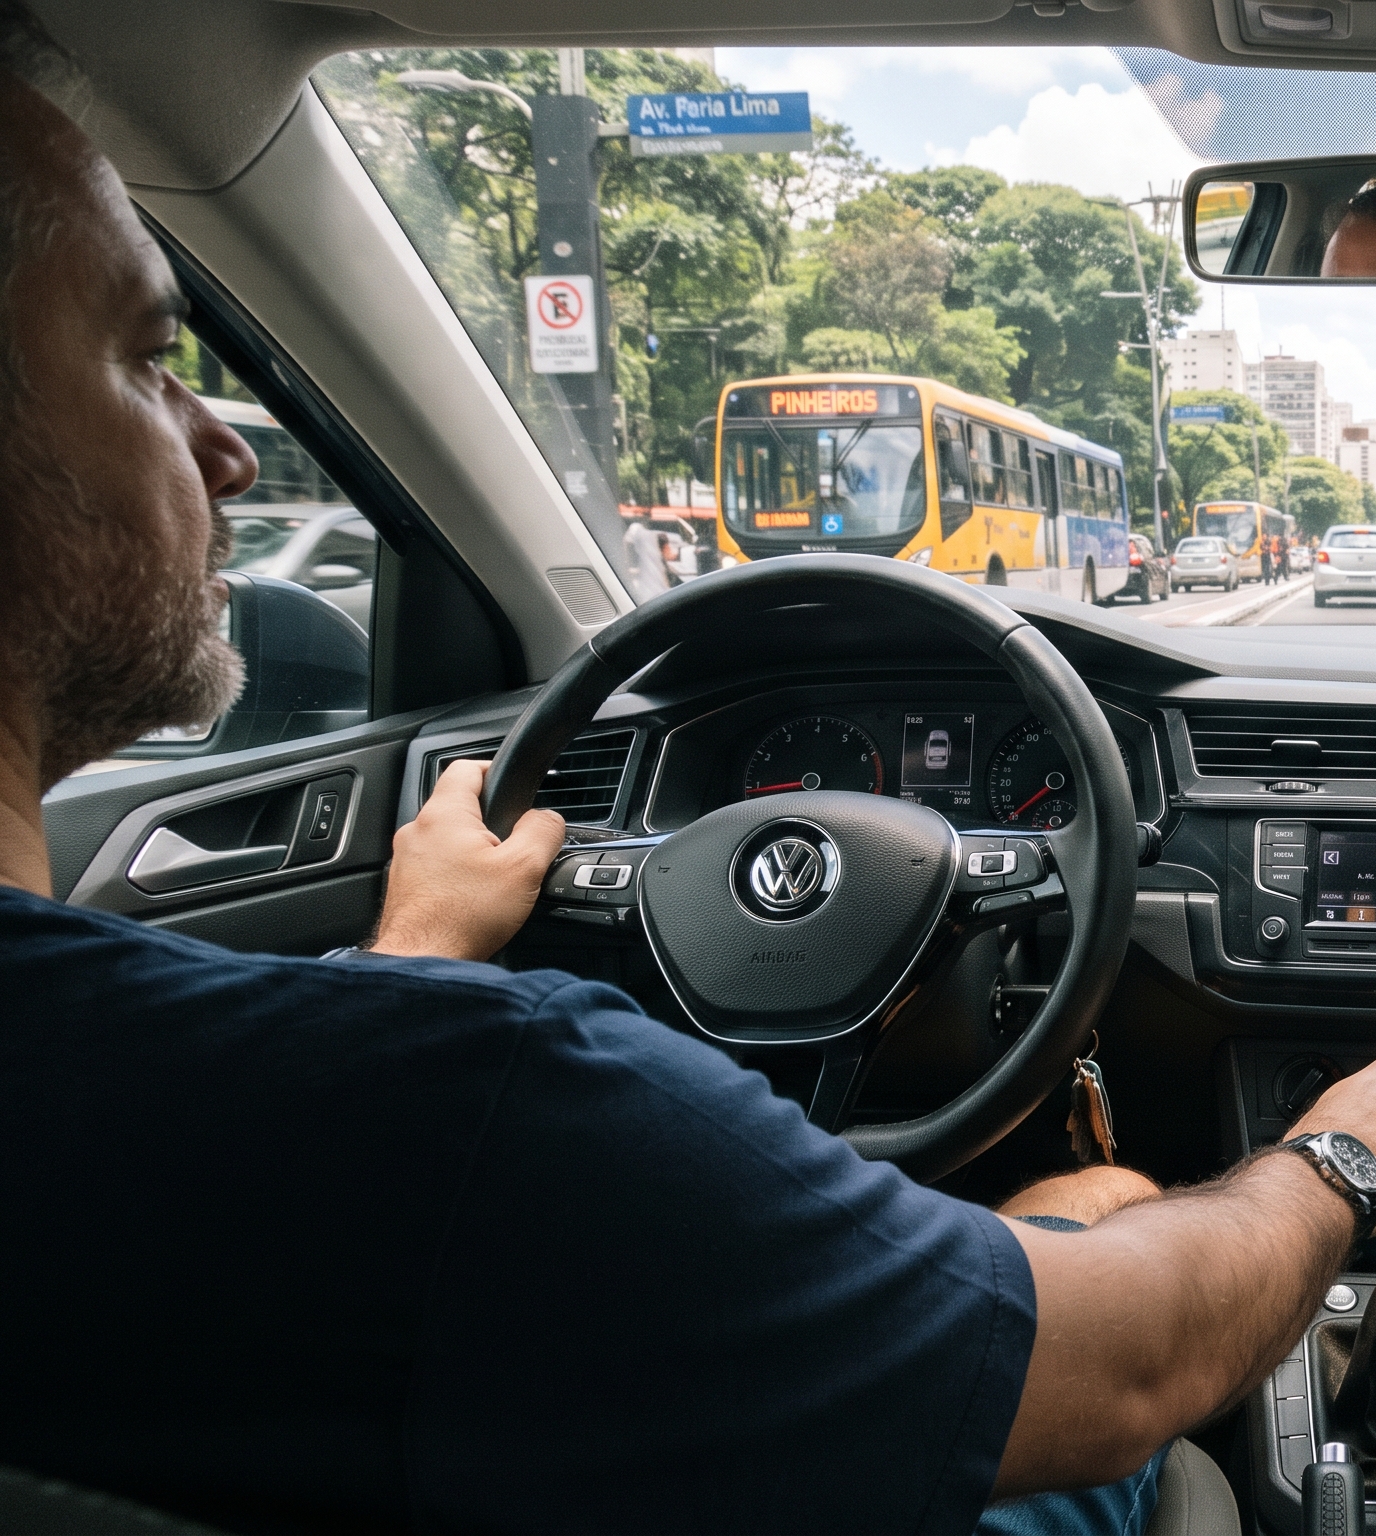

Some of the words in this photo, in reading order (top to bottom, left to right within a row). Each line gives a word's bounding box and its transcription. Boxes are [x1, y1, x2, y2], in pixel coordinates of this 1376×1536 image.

[640, 97, 670, 120] Av.
[730, 93, 780, 117] Lima
[771, 389, 878, 415] PINHEIROS
[1000, 778, 1012, 787] 20
[1001, 794, 1012, 802] 10
[750, 949, 808, 964] AIRBAG
